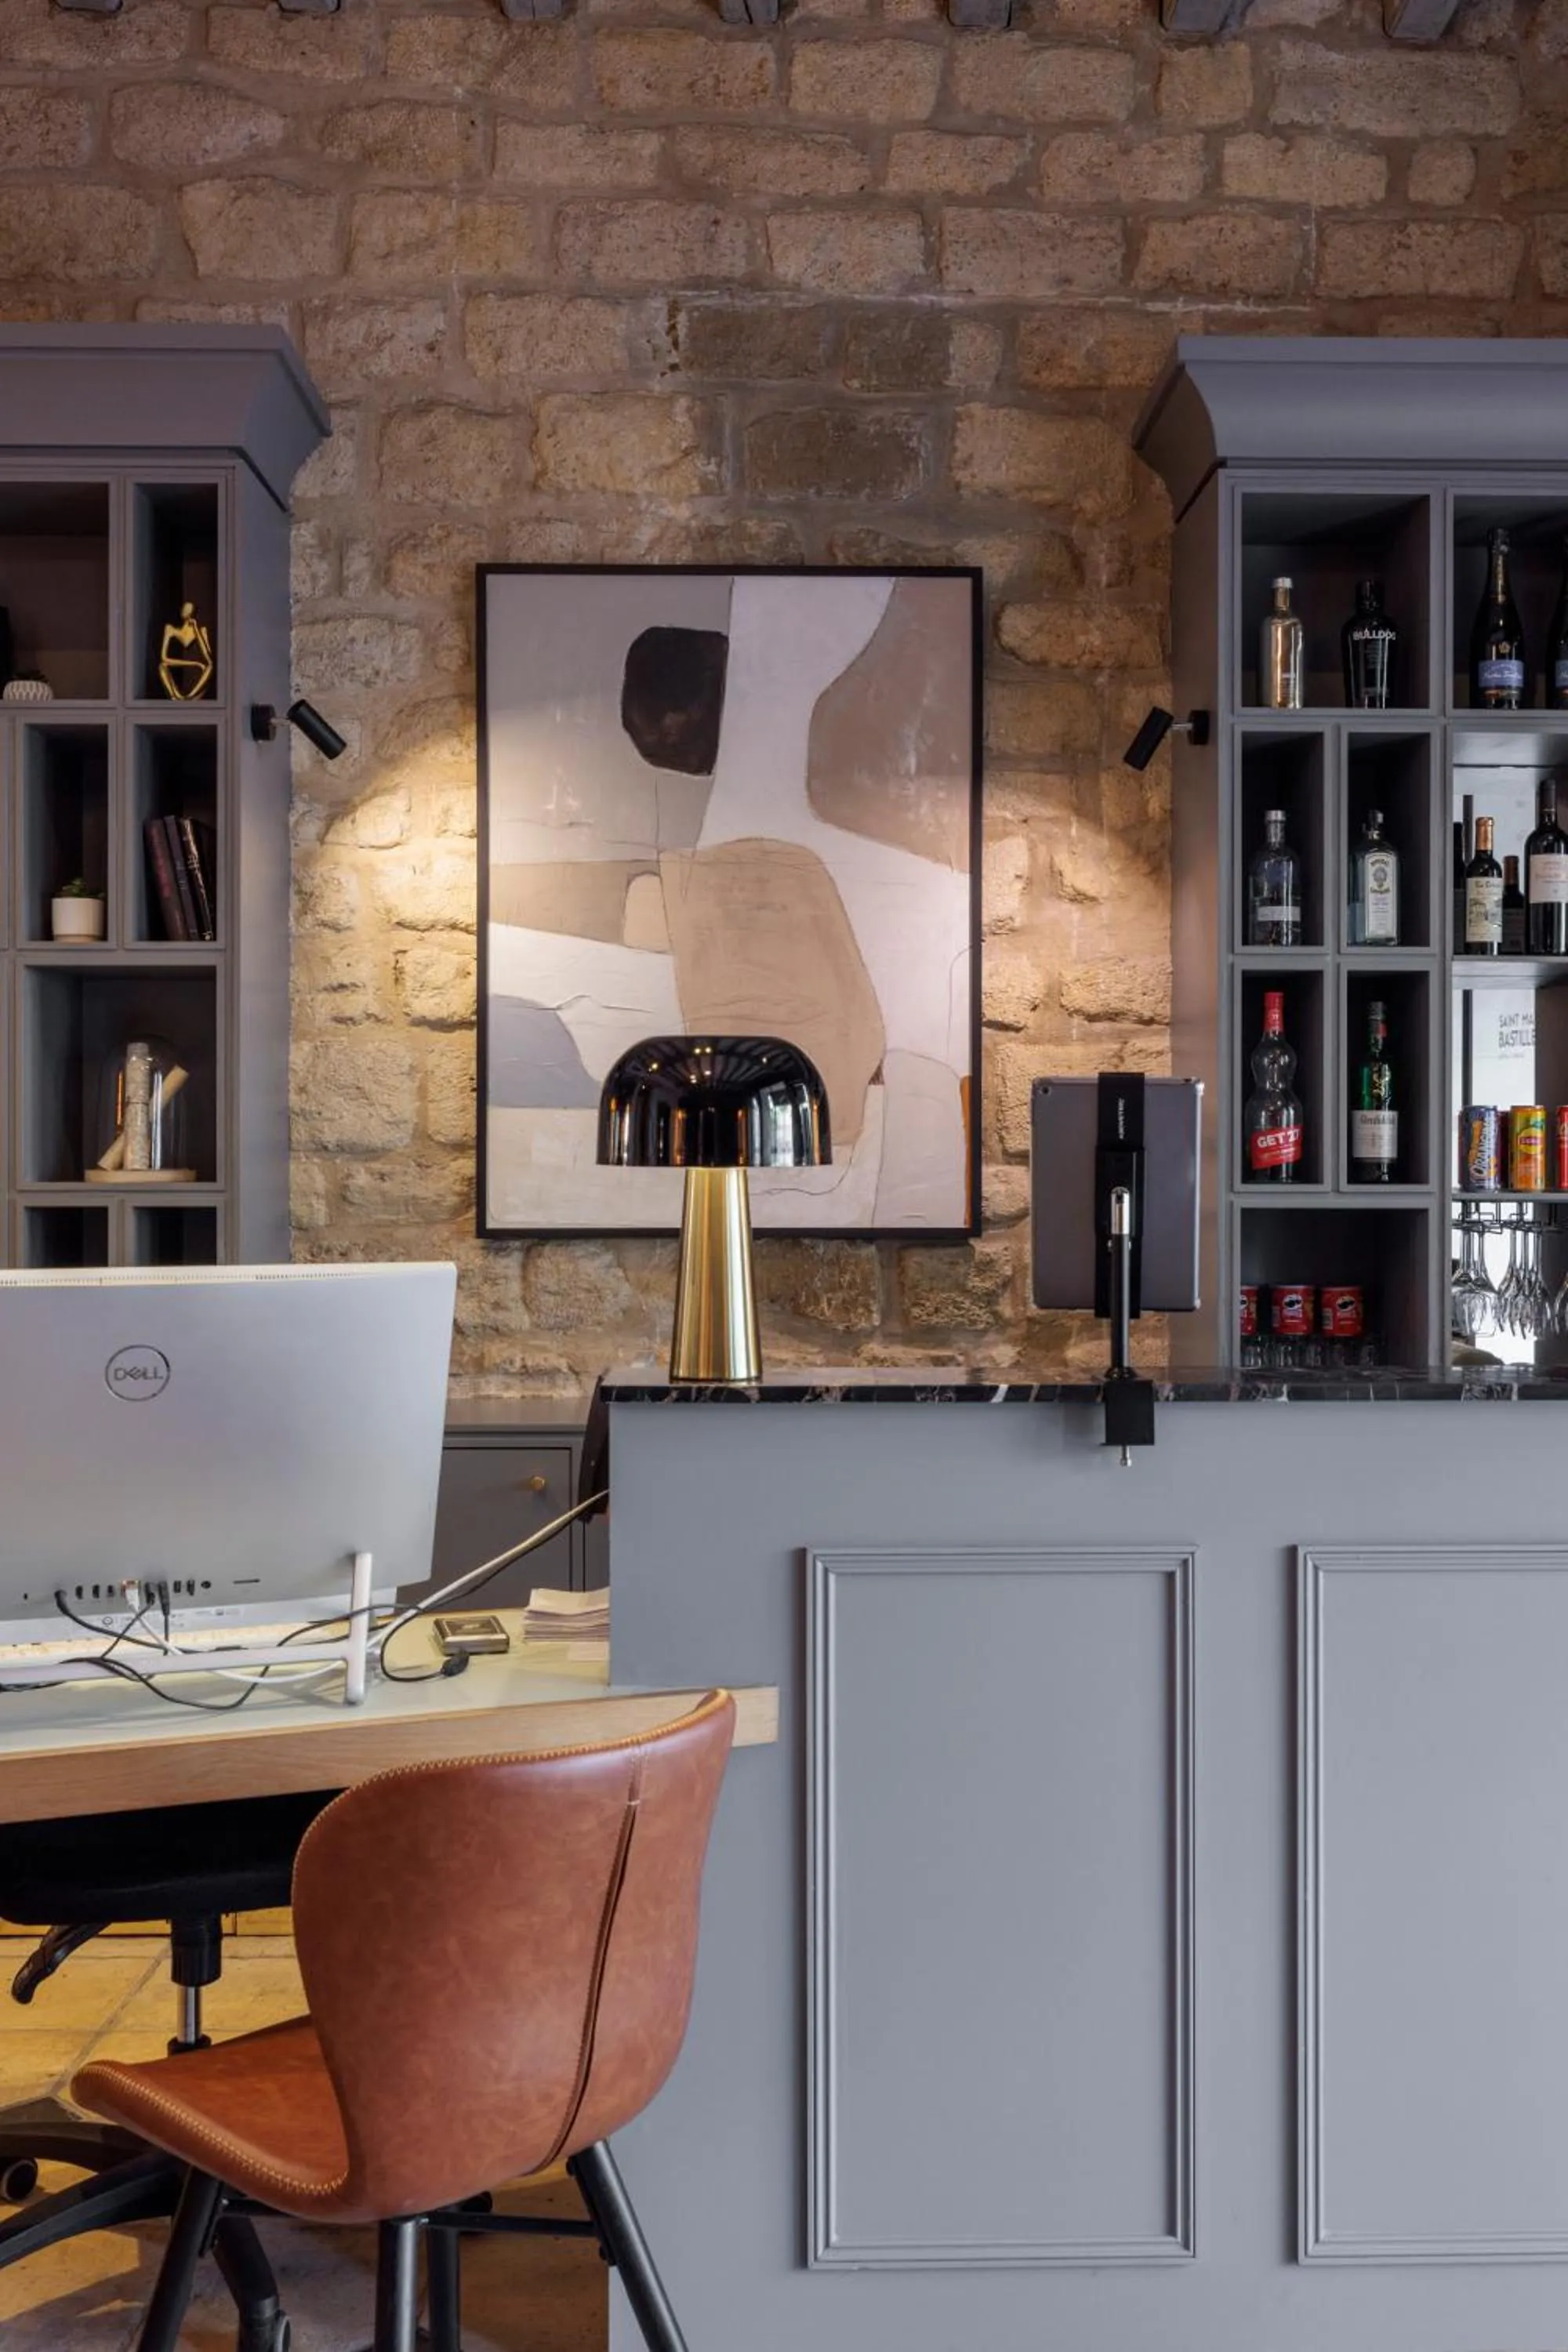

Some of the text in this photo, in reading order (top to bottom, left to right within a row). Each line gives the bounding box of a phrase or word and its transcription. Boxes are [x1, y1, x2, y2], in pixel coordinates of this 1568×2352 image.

[1498, 1014, 1519, 1027] SAINT
[1257, 1131, 1286, 1148] GET
[114, 1367, 164, 1381] DELL
